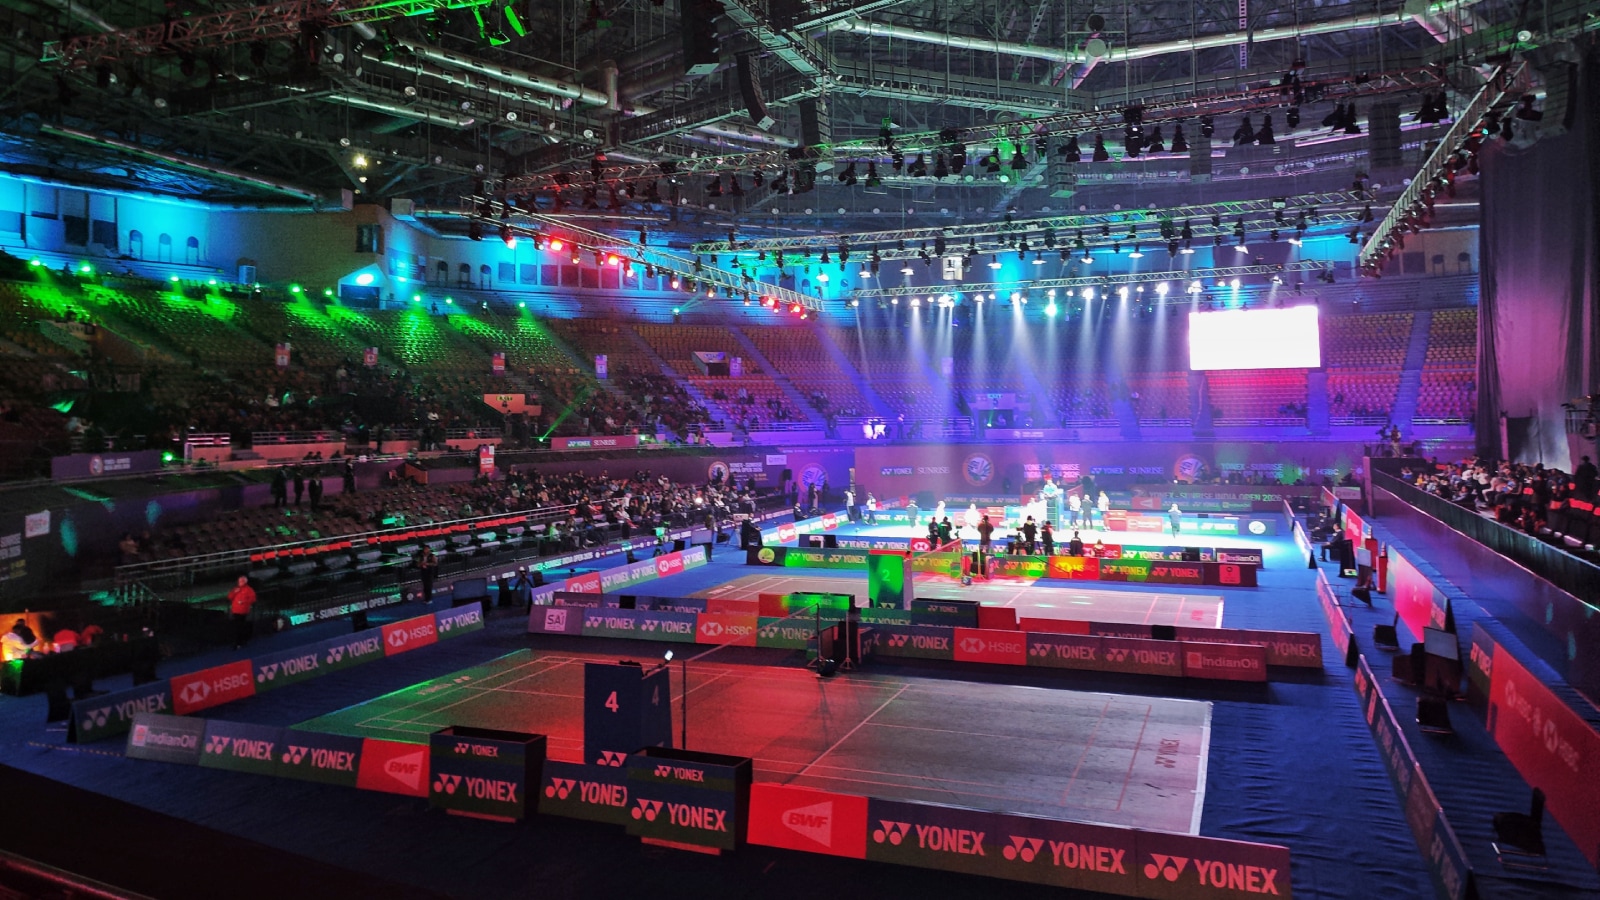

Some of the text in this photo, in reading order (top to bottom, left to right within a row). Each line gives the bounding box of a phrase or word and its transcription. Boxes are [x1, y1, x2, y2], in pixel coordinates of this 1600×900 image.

[1129, 466, 1164, 474] SUNRISE
[850, 540, 870, 548] YONEX
[888, 542, 908, 550] YONEX
[802, 554, 825, 562] YONEX
[844, 554, 866, 564] YONEX
[1140, 552, 1164, 560] YONEX
[1228, 554, 1261, 562] IndianOil
[1020, 562, 1046, 570] YONEX
[1120, 566, 1148, 576] YONEX
[1170, 568, 1199, 578] YONEX
[882, 569, 890, 582] 2
[368, 596, 386, 609] OPEN
[454, 610, 482, 628] YONEX
[605, 618, 635, 630] YONEX
[661, 620, 692, 634] YONEX
[410, 624, 434, 640] HSBC
[725, 625, 752, 636] HSBC
[346, 636, 381, 658] YONEX
[912, 636, 950, 650] YONEX
[988, 641, 1022, 654] HSBC
[1272, 642, 1316, 658] YONEX
[1055, 644, 1096, 660] YONEX
[1132, 650, 1176, 666] YONEX
[281, 654, 320, 676] YONEX
[1202, 656, 1258, 669] IndianOil
[212, 673, 250, 693] HSBC
[604, 690, 620, 713] 4
[652, 684, 660, 706] 4
[116, 692, 168, 721] YONEX
[147, 730, 198, 749] IndianOil
[232, 738, 274, 760] YONEX
[471, 744, 499, 758] YONEX
[310, 748, 356, 772] YONEX
[388, 762, 418, 774] BWF
[672, 766, 704, 782] YONEX
[464, 776, 518, 804] YONEX
[667, 802, 727, 833] YONEX
[788, 812, 828, 829] BWF
[915, 824, 986, 856] YONEX
[1049, 840, 1129, 875] YONEX
[1194, 858, 1280, 896] YONEX
